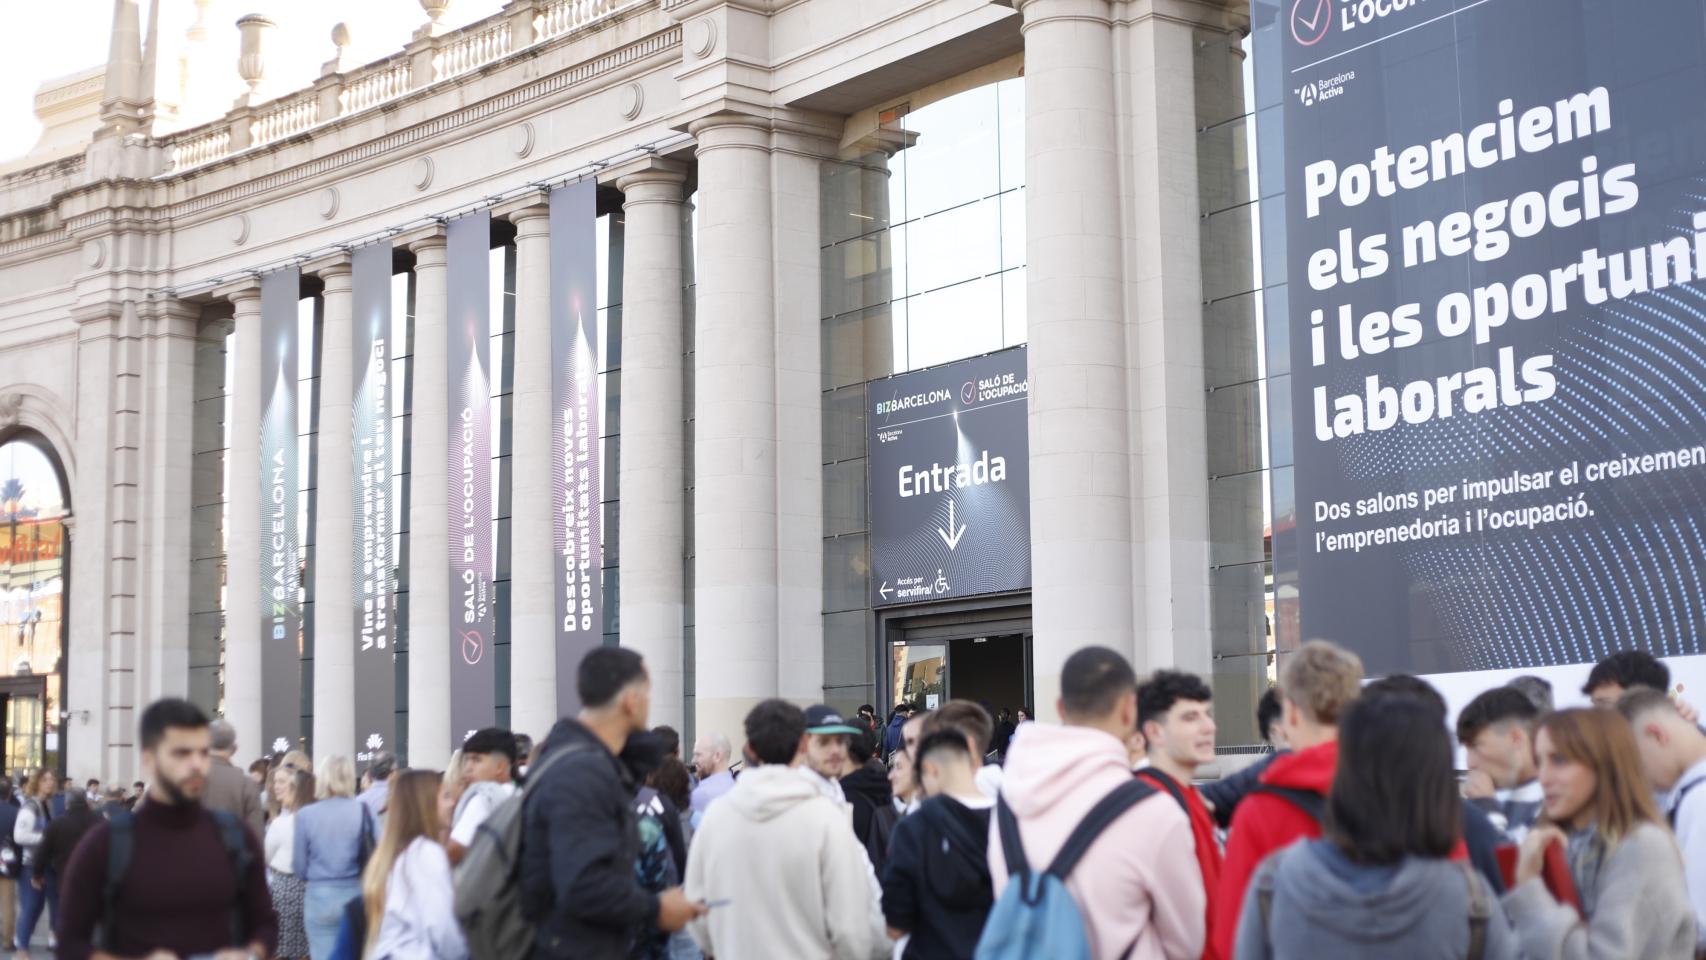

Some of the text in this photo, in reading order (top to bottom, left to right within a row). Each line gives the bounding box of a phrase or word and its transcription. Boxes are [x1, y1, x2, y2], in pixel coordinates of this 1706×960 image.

[1318, 71, 1355, 91] Barcelona
[1318, 86, 1344, 102] Activa
[1305, 86, 1611, 218] Potenciem
[1308, 155, 1640, 291] els negocis
[1311, 211, 1706, 367] i les oportuni
[876, 388, 952, 415] BIZBARCELONA
[979, 373, 1015, 391] SALÓ DE
[979, 379, 1029, 403] L'OCUPACIÓ
[1314, 346, 1557, 442] laborals
[372, 338, 387, 649] a transformar el teu negoci
[460, 407, 476, 624] SALÓ DE L'OCUPACIÓ
[563, 408, 577, 632] Descobreix noves
[898, 449, 1007, 498] Entrada
[1315, 445, 1706, 522] Dos salons per impulsar el creixemen
[271, 448, 287, 640] BIZBARCELONA
[361, 437, 376, 651] Vine a emprendre i
[577, 466, 594, 631] oportunitats
[1315, 492, 1596, 554] l'emprenedoria i l'ocupació.
[914, 576, 924, 585] per
